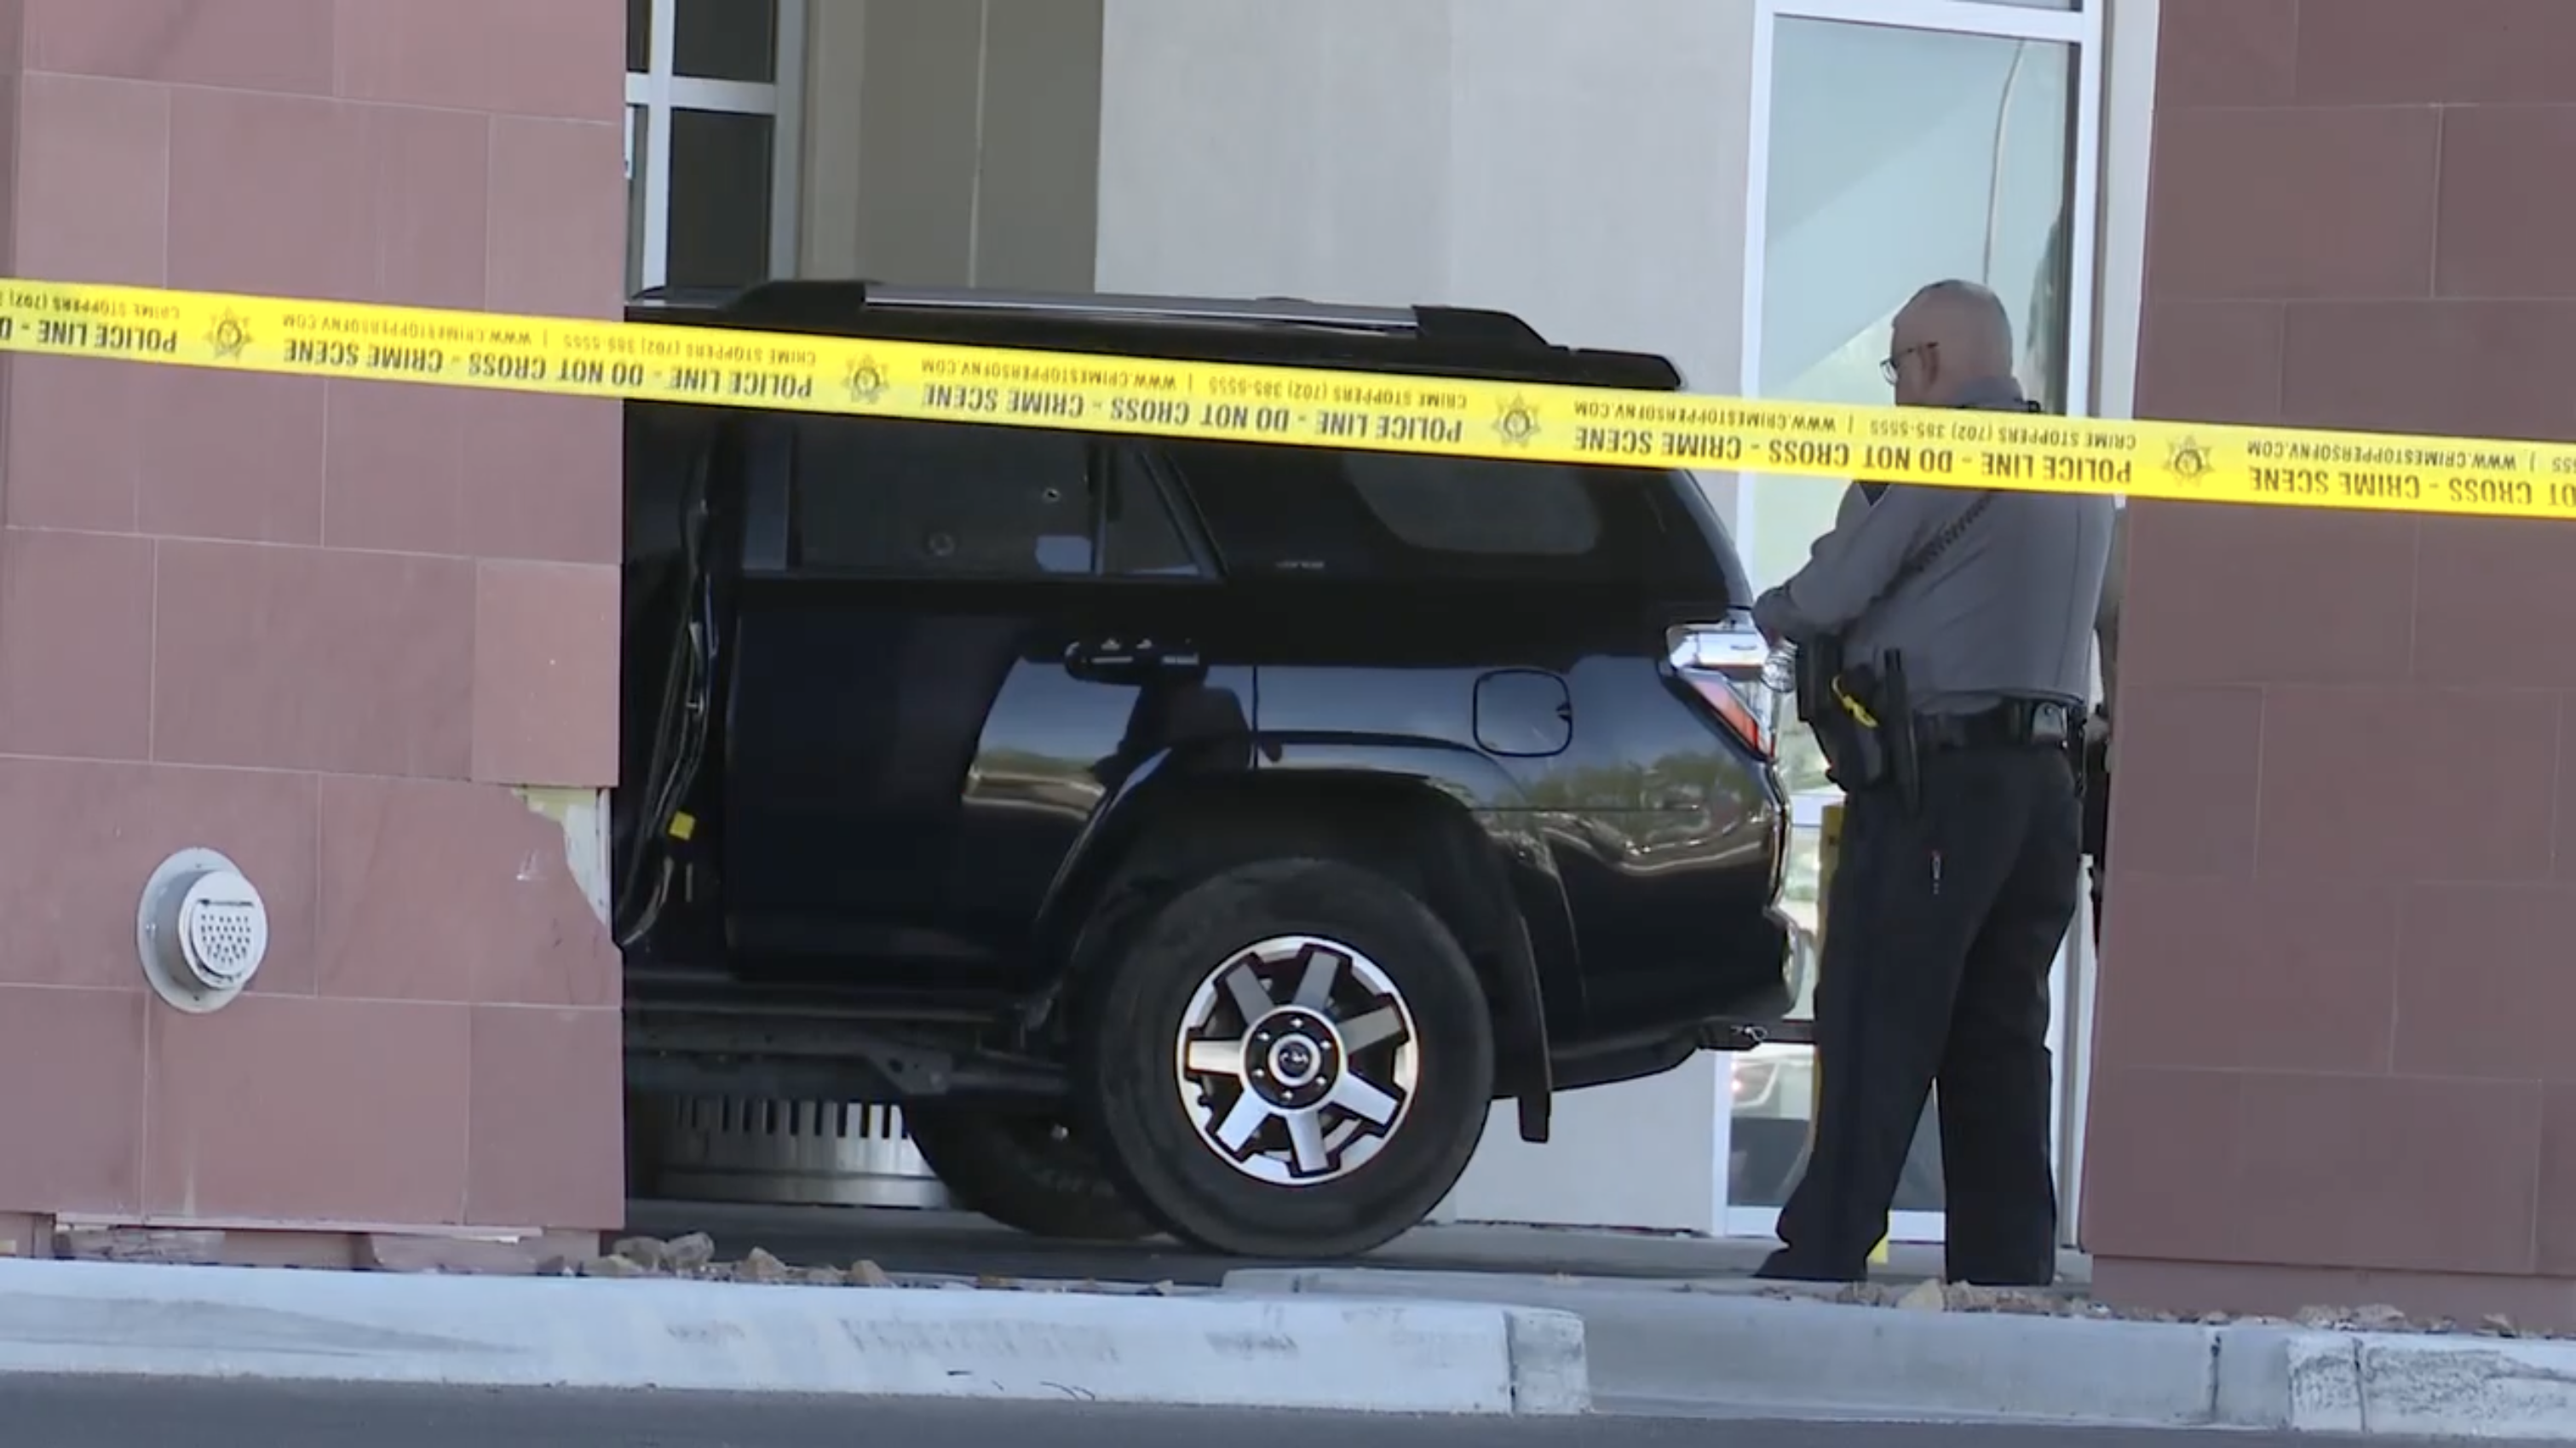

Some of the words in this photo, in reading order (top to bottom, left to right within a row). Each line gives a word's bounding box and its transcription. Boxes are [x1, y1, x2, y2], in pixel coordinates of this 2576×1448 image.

[9, 291, 48, 312] (702)
[53, 296, 126, 318] STOPPERS
[37, 319, 87, 348] LINE
[95, 324, 177, 354] POLICE
[641, 336, 681, 358] (702)
[284, 337, 359, 367] SCENE
[368, 343, 443, 373] CRIME
[469, 350, 545, 381] CROSS
[686, 341, 762, 363] STOPPERS
[770, 348, 815, 367] CRIME
[556, 357, 604, 385] NOT
[609, 360, 644, 388] DO
[670, 365, 721, 394] LINE
[727, 369, 813, 400] POLICE
[922, 383, 998, 413] SCENE
[1009, 389, 1084, 419] CRIME
[1288, 381, 1327, 402] (702)
[1333, 386, 1411, 407] STOPPERS
[1420, 392, 1467, 411] CRIME
[1111, 396, 1189, 426] CROSS
[1201, 402, 1247, 430] NOT
[1256, 406, 1290, 433] DO
[1320, 410, 1368, 438] LINE
[1377, 414, 1462, 444] POLICE
[1574, 426, 1652, 456] SCENE
[1870, 419, 1944, 440] 385-5555
[1952, 422, 1993, 443] (702)
[1998, 426, 2080, 447] STOPPERS
[2086, 431, 2136, 451] CRIME
[1662, 432, 1741, 461] CRIME
[1768, 438, 1850, 468] CROSS
[1862, 444, 1910, 471] NOT
[1919, 447, 1952, 474] DO
[1981, 451, 2033, 478] LINE
[2044, 454, 2131, 484] POLICE
[2249, 465, 2329, 494] SCENE
[2338, 470, 2419, 499] CRIME
[2448, 476, 2532, 505] CROSS
